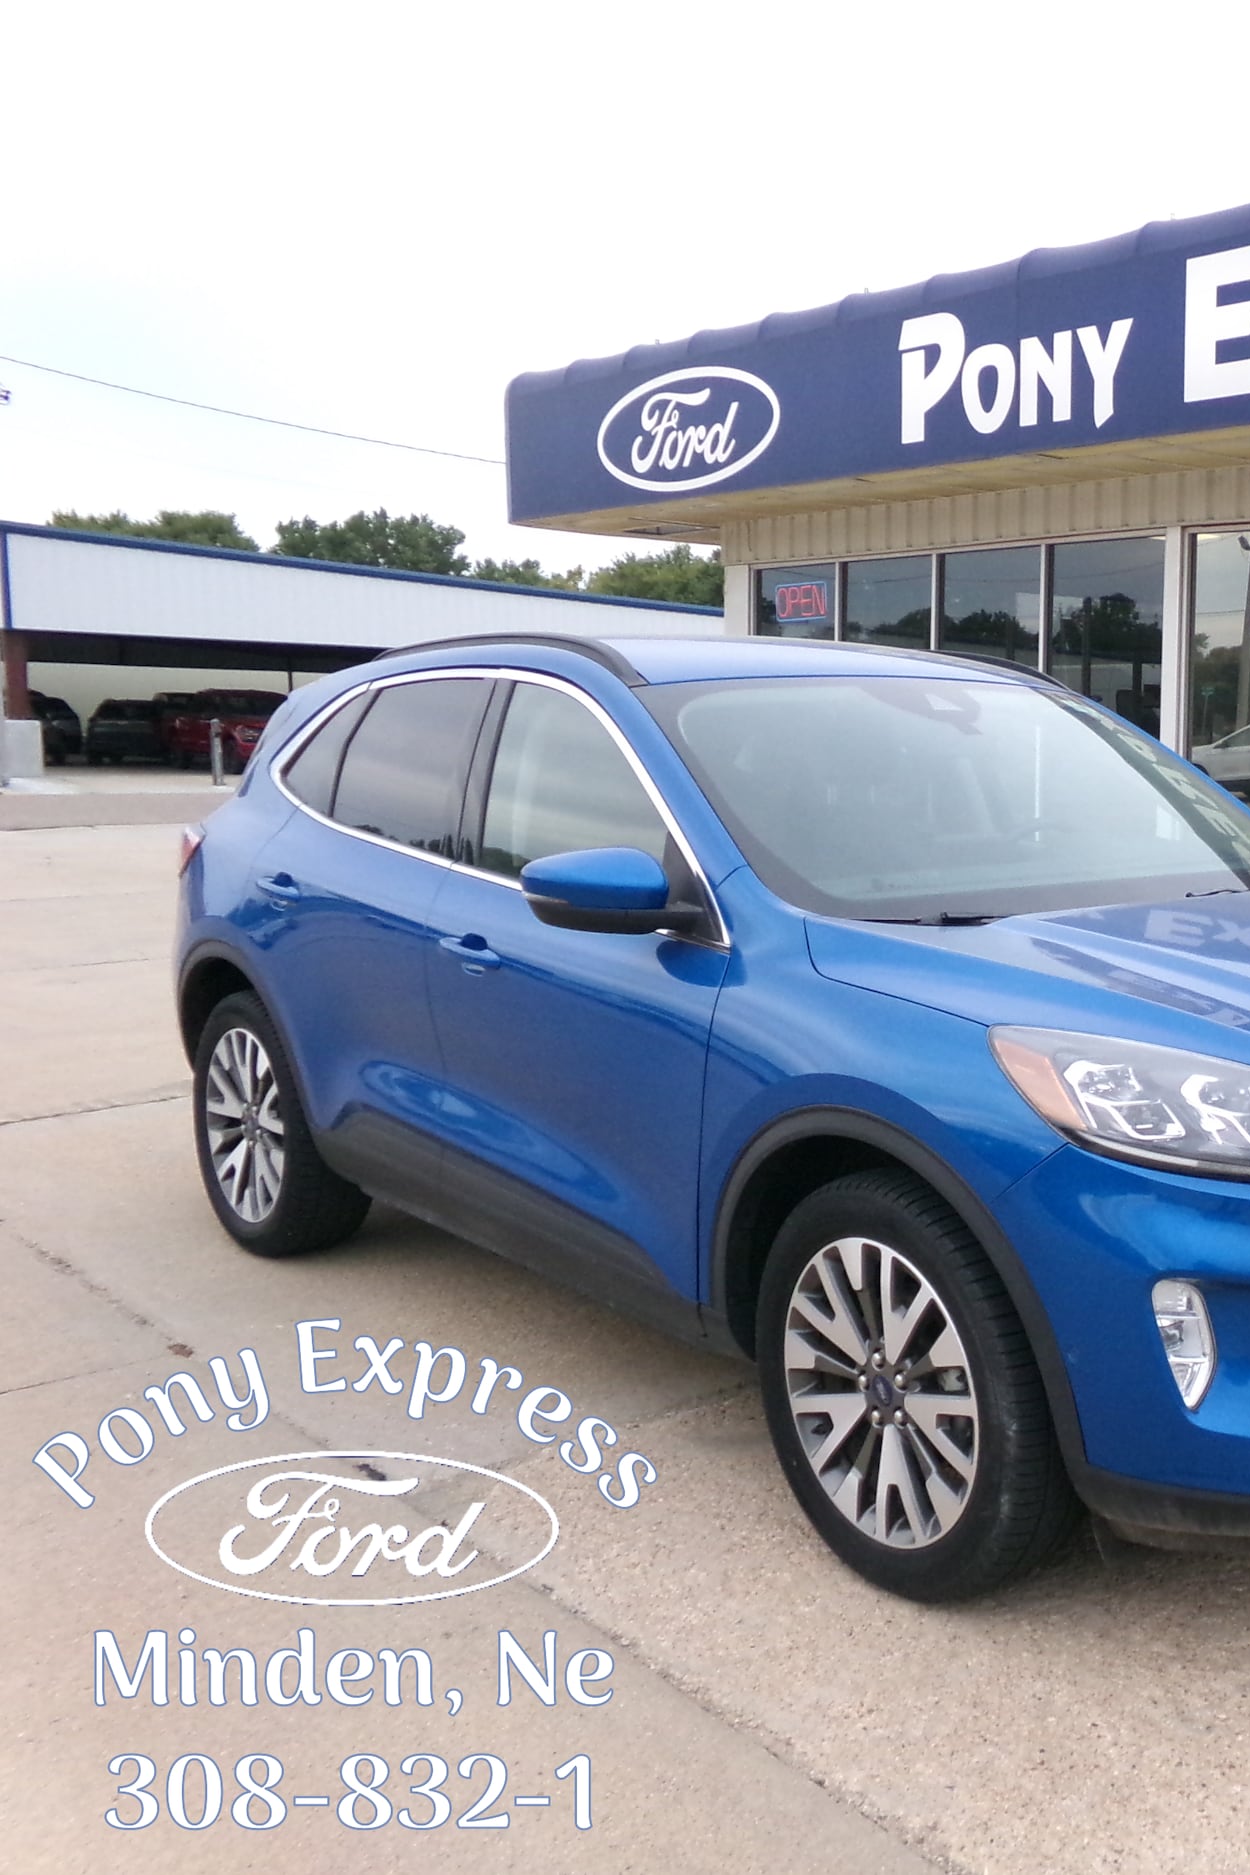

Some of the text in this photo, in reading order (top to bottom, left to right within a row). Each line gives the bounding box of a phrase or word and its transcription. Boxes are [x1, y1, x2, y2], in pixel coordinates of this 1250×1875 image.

[898, 312, 1133, 445] PONY
[631, 387, 739, 474] Ford
[777, 584, 826, 618] OPEN
